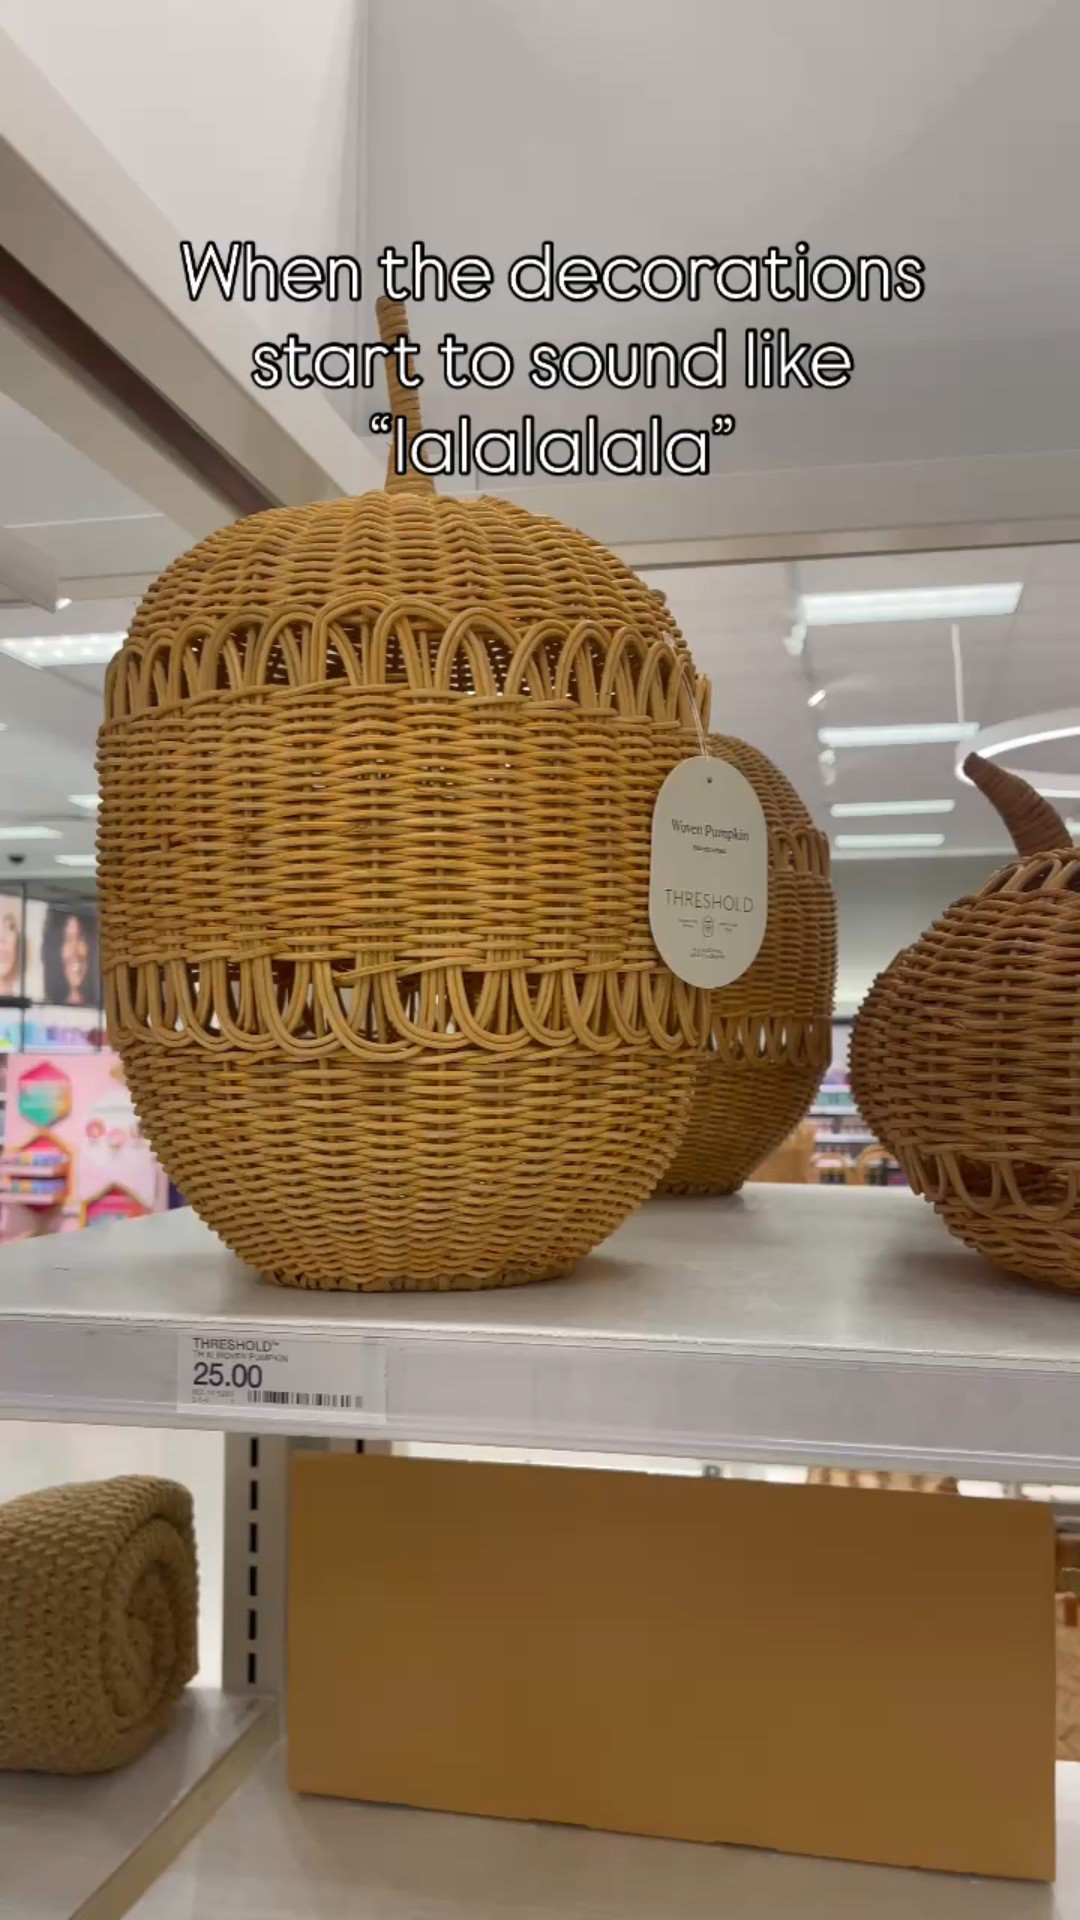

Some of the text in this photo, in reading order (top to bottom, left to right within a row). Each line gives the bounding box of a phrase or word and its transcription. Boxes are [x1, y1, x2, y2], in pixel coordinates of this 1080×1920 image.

[671, 818, 750, 841] Woven Pumpkin
[664, 888, 754, 913] THRESHOLD
[193, 1361, 263, 1388] 25.00
